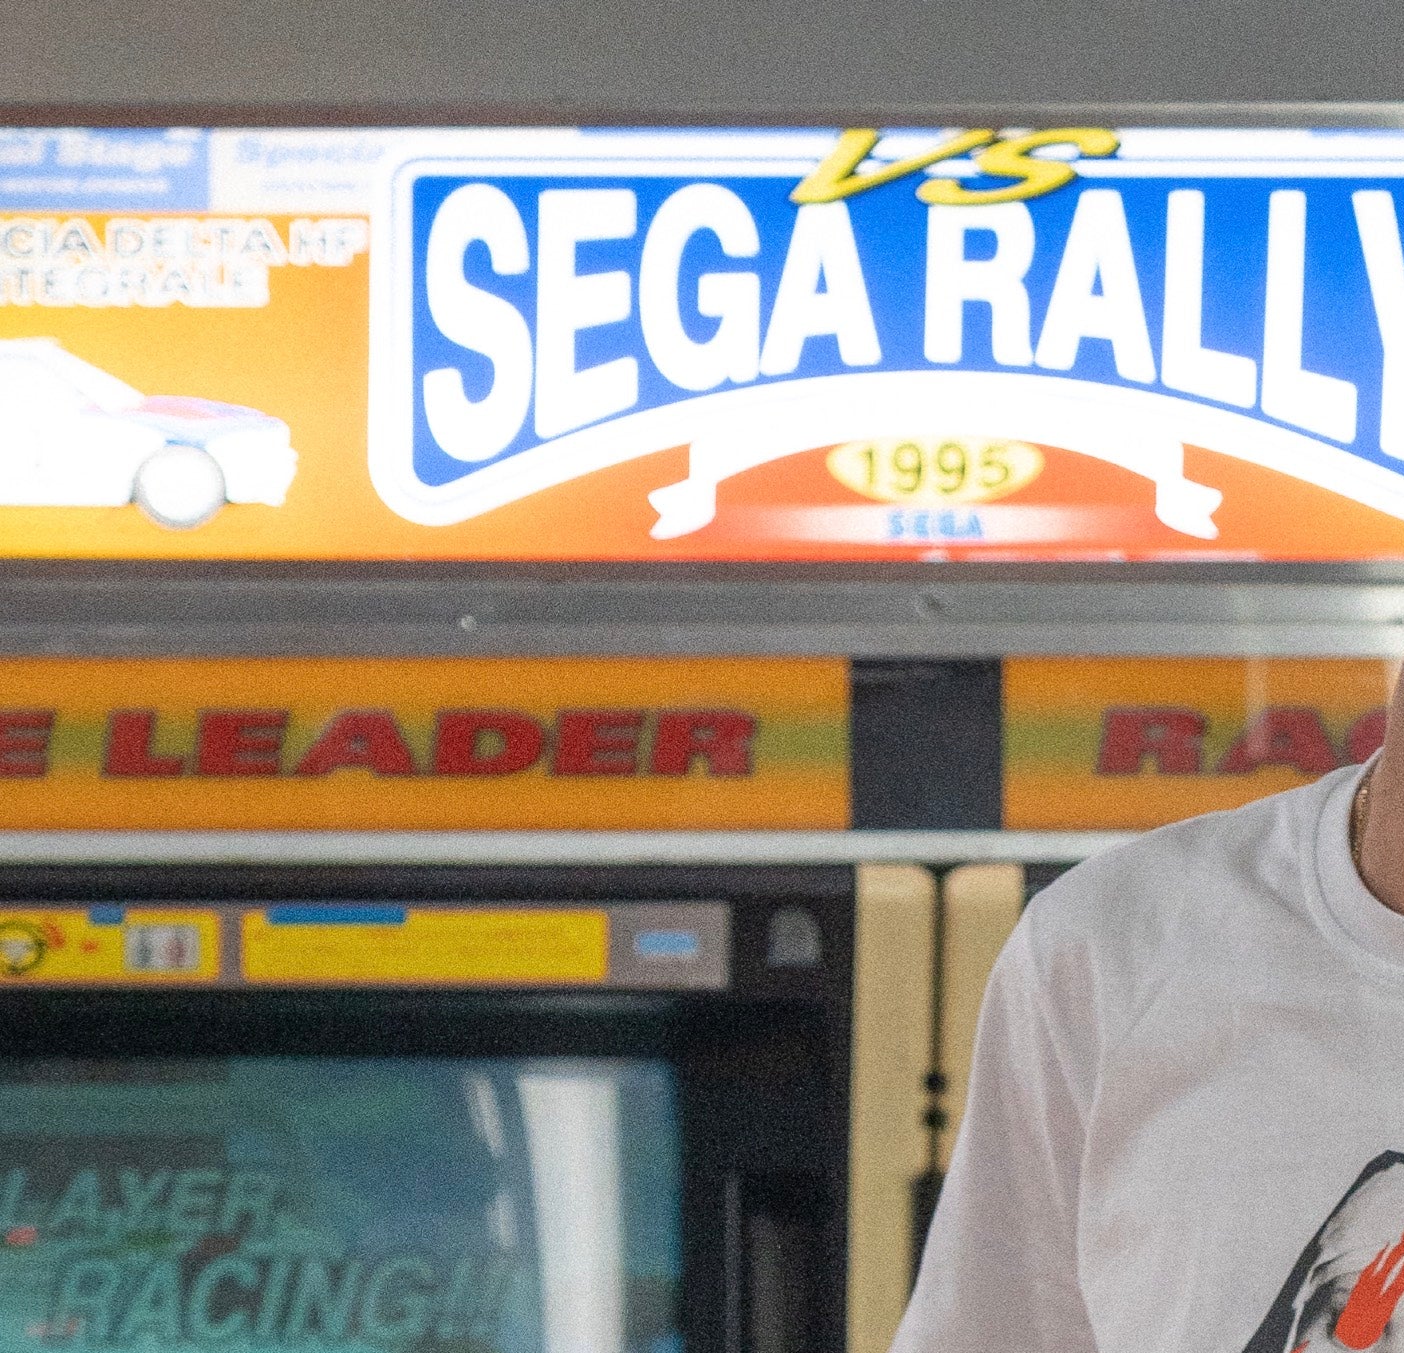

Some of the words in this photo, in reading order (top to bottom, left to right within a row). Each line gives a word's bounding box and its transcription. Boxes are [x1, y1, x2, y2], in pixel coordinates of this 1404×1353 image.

[423, 183, 883, 464] SEGA
[857, 441, 1014, 495] 1995
[887, 510, 986, 539] SEGA
[101, 707, 758, 779] LEADER
